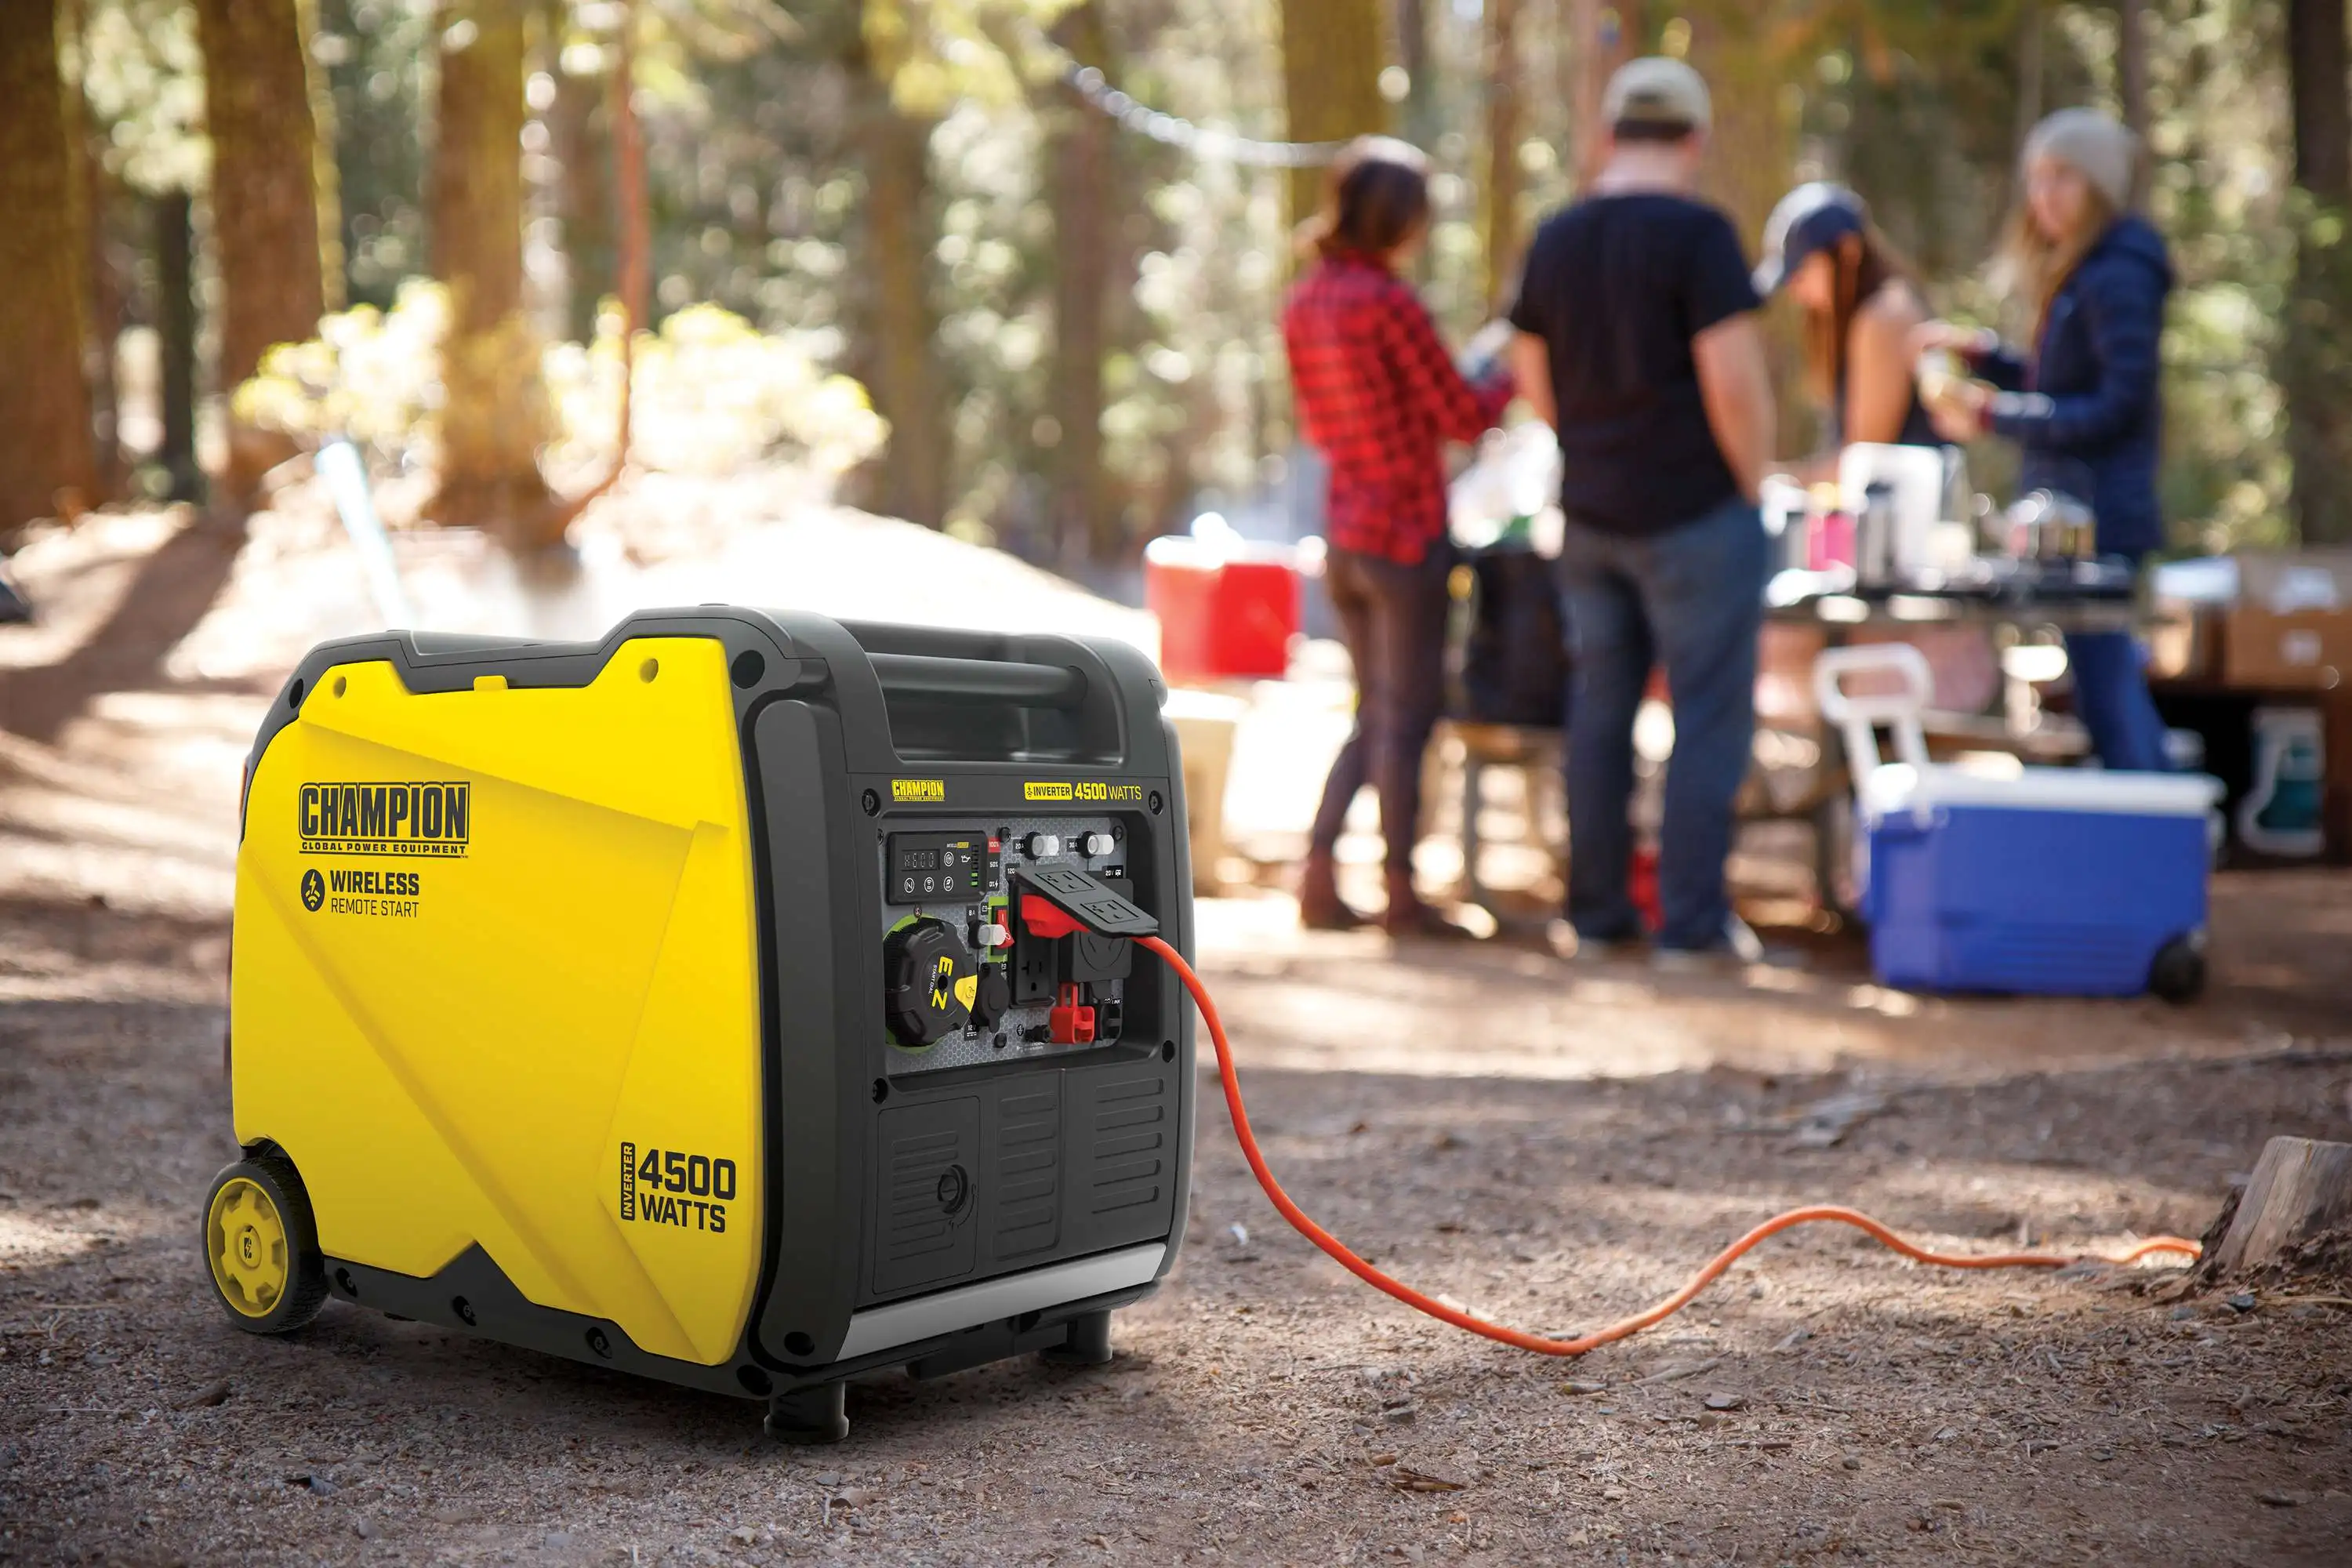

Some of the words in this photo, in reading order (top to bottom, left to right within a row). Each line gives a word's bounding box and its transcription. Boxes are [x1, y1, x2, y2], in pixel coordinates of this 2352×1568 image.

[893, 781, 944, 796] CHAMPION
[1033, 786, 1071, 797] INVERTER
[1075, 782, 1106, 800] 4500
[1109, 786, 1142, 800] WATTS
[300, 785, 469, 840] CHAMPION
[302, 841, 343, 851] GLOBAL
[347, 843, 387, 852] POWER
[393, 844, 466, 854] EQUIPMENT
[330, 869, 419, 896] WIRELESS
[331, 898, 377, 916] REMOTE
[381, 900, 419, 918] START
[622, 1145, 633, 1218] INVERTER
[638, 1149, 736, 1200] 4500
[640, 1192, 726, 1233] WATTS
